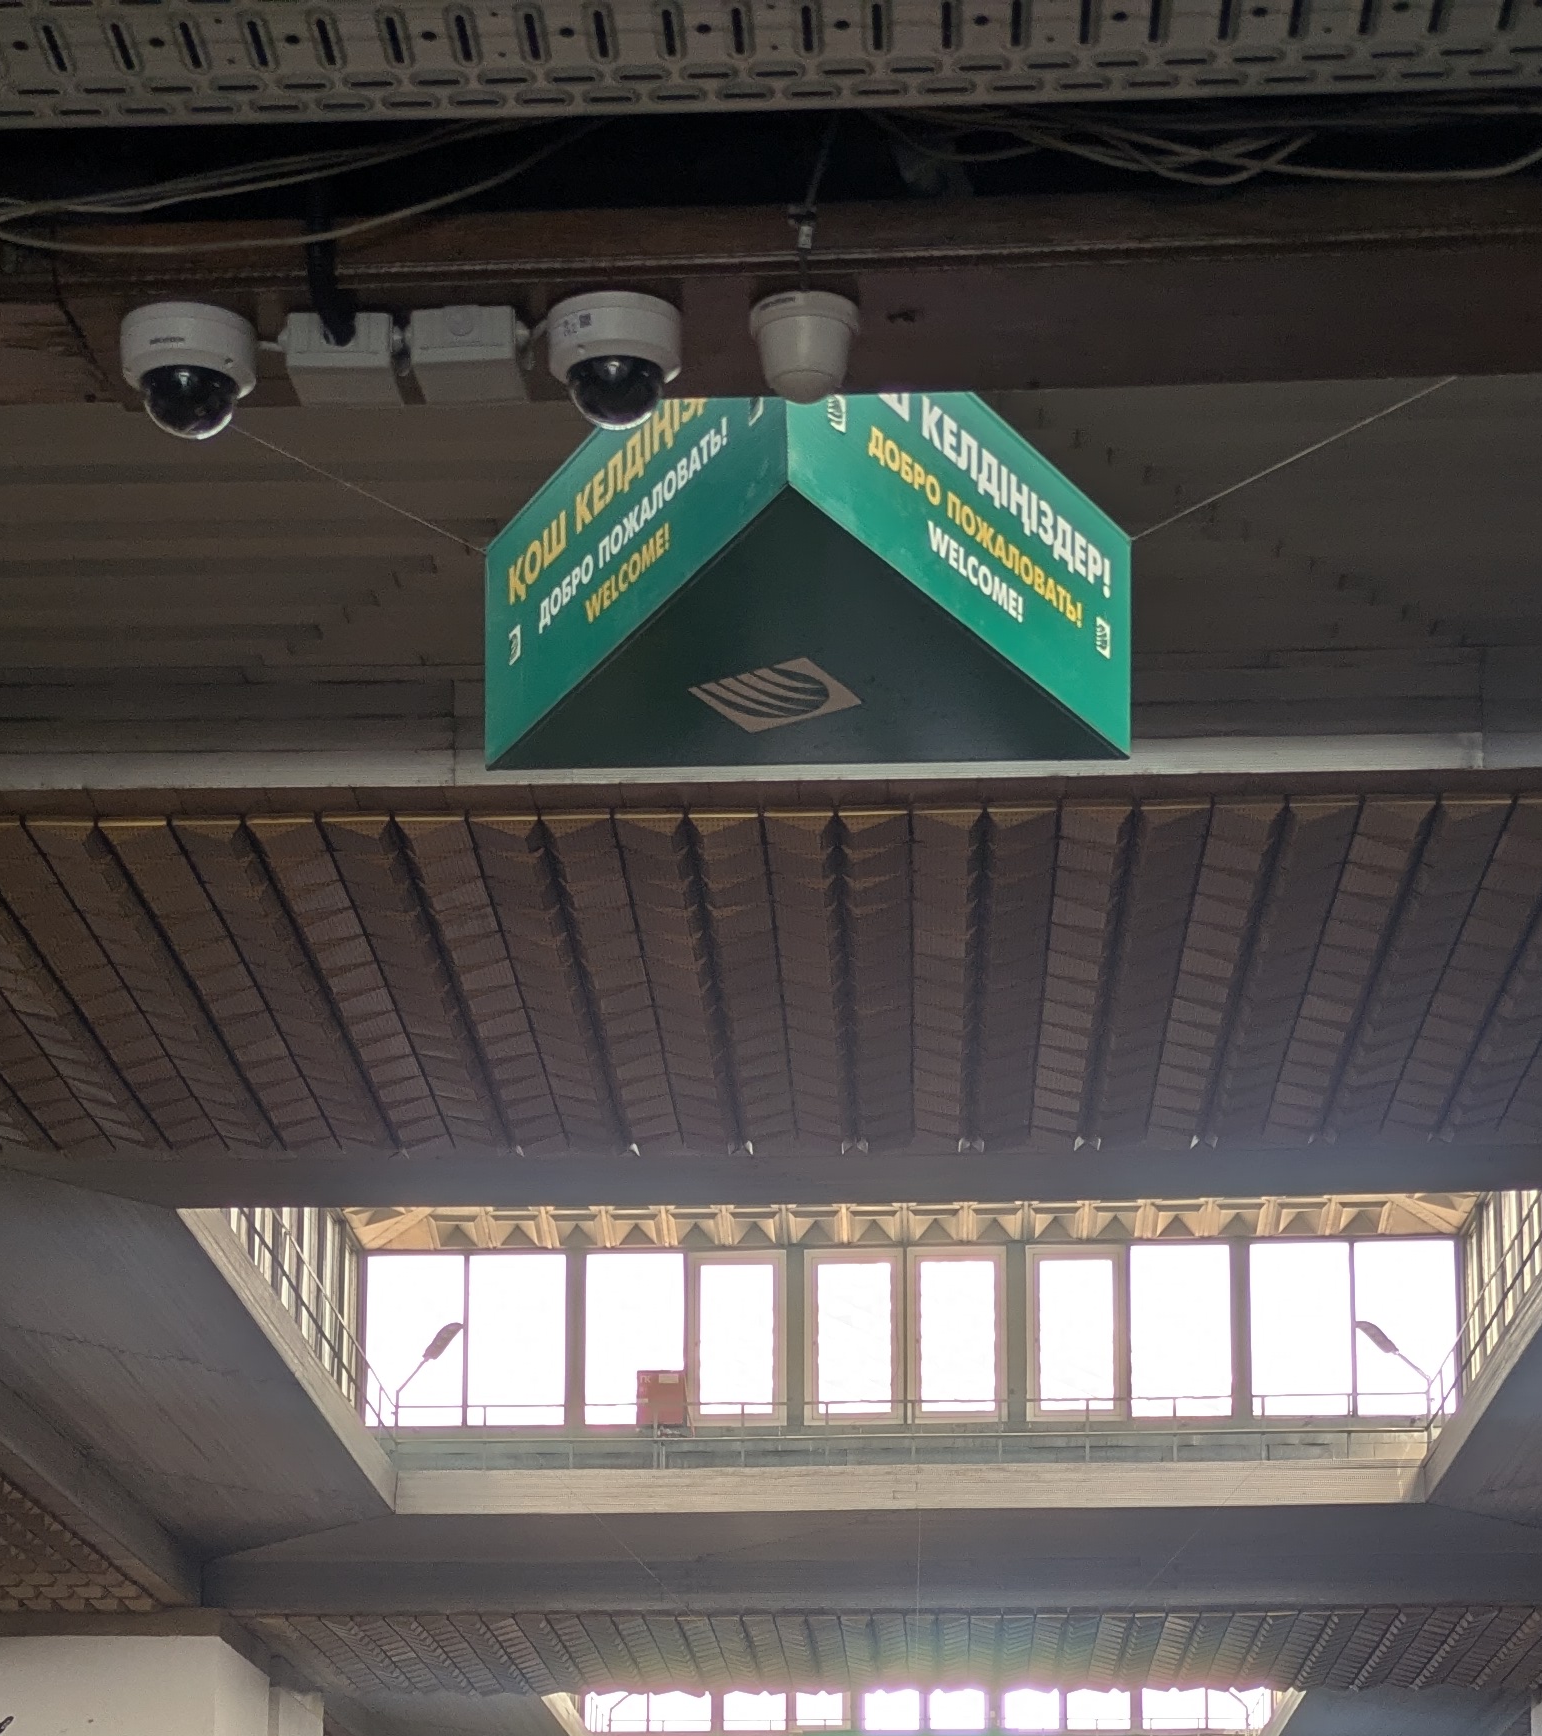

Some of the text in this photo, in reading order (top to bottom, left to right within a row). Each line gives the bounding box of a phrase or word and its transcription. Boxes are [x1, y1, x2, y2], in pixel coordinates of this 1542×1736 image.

[508, 399, 708, 606] ҚОШ КЕЛДІҢІЗ
[538, 416, 729, 635] ДОБРО ПОЖАЛОВАТЬ!
[585, 522, 671, 624] WELCOME!
[868, 425, 1083, 629] ДОБРО ПОЖАЛОВАТЬ!
[921, 395, 1111, 599] КЕЛДІҢІЗДЕР!
[927, 520, 1024, 623] WELCOME!
